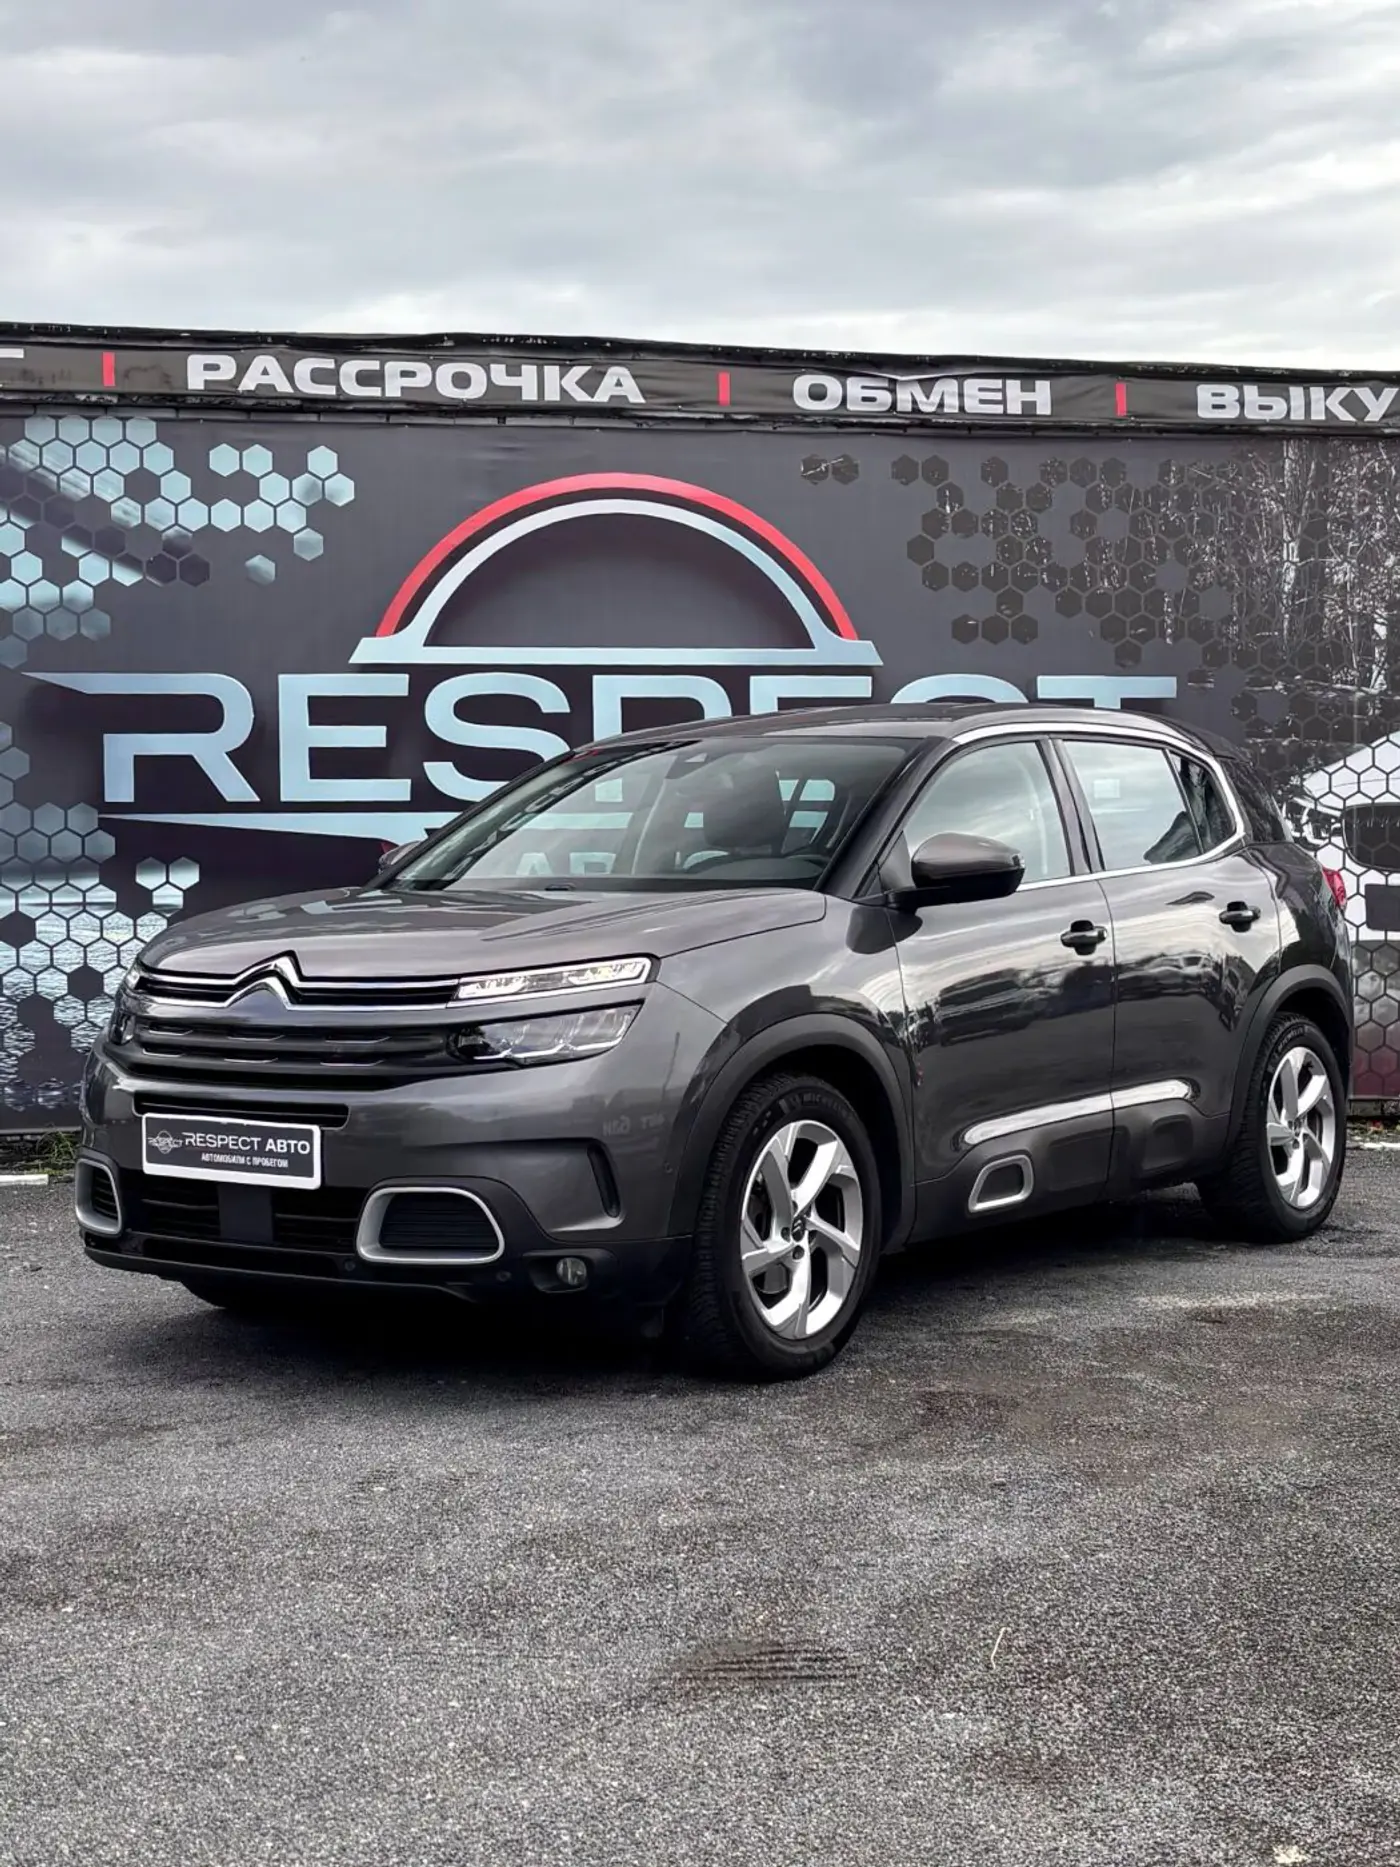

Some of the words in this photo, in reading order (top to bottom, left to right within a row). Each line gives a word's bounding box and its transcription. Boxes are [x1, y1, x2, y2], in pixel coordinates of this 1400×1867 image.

[187, 354, 646, 404] РАССРОЧКА
[793, 374, 1051, 416] ОБМЕН
[182, 1132, 261, 1151] RESPECT
[265, 1138, 311, 1155] АВТО
[201, 1152, 245, 1165] АВТОМОБИЛИ
[246, 1156, 252, 1166] С
[253, 1156, 289, 1168] ПРОБЕГОМ
